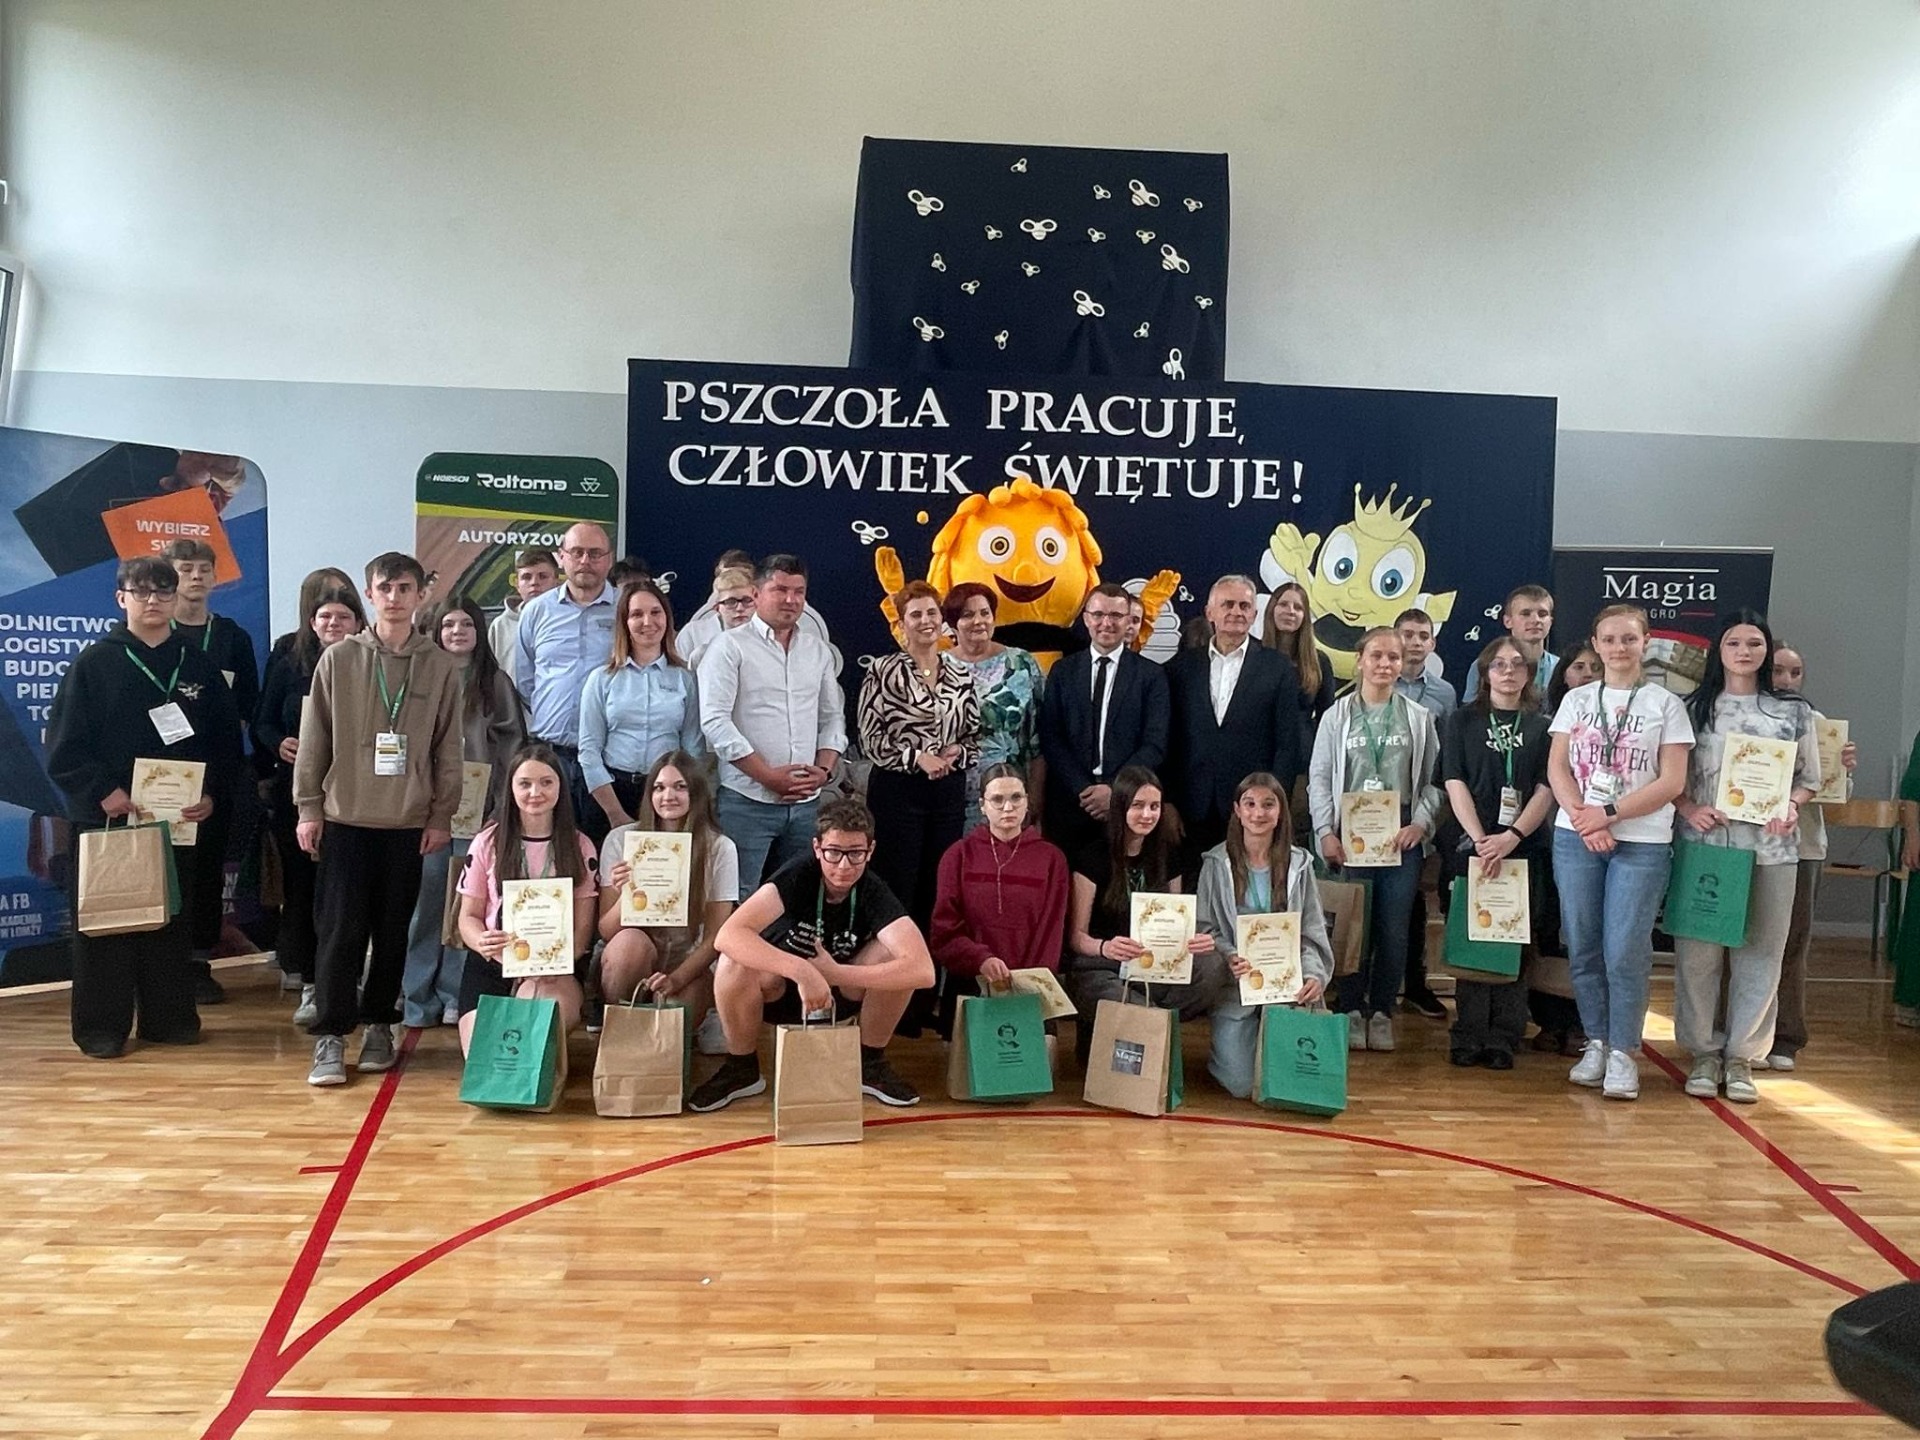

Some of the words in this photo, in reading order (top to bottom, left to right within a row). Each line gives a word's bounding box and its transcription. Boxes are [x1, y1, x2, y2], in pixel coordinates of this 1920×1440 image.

[662, 380, 950, 429] PSZCZOŁA
[985, 389, 1245, 449] PRACUJE,
[668, 444, 973, 494] CZŁOWIEK
[476, 473, 568, 492] Roltoma
[135, 519, 211, 537] WYBIERZ
[1602, 574, 1718, 607] Magia
[1644, 608, 1677, 620] GRO
[0, 636, 96, 655] OGISTY
[16, 682, 59, 699] PIE
[1611, 712, 1647, 734] RE
[1346, 736, 1369, 750] BES
[12, 893, 31, 910] FB
